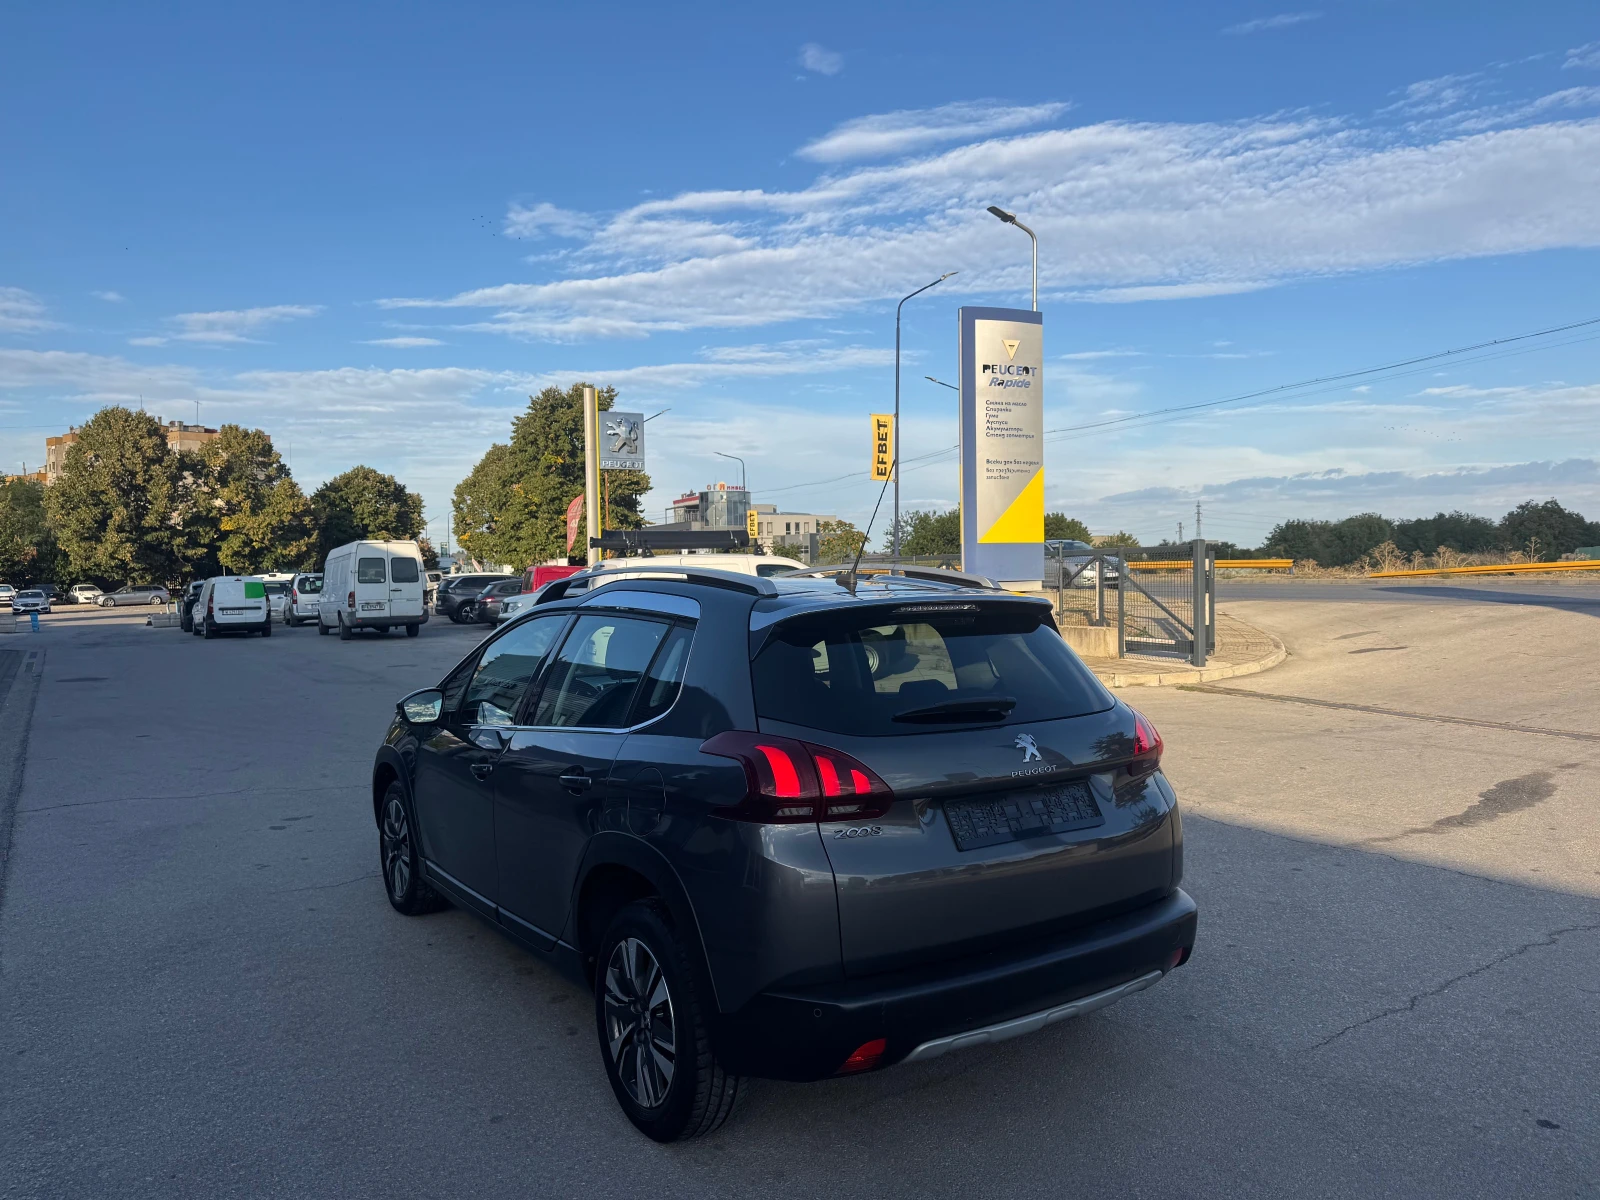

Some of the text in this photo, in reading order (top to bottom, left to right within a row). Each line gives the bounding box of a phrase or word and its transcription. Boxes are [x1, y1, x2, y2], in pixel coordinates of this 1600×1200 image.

[982, 364, 1037, 377] PEUGEOT
[988, 377, 1031, 389] Rapide
[877, 418, 888, 476] EFBET
[602, 460, 643, 469] PEUGEOT
[1010, 764, 1058, 779] PEUGEOT
[833, 825, 884, 840] 2008
